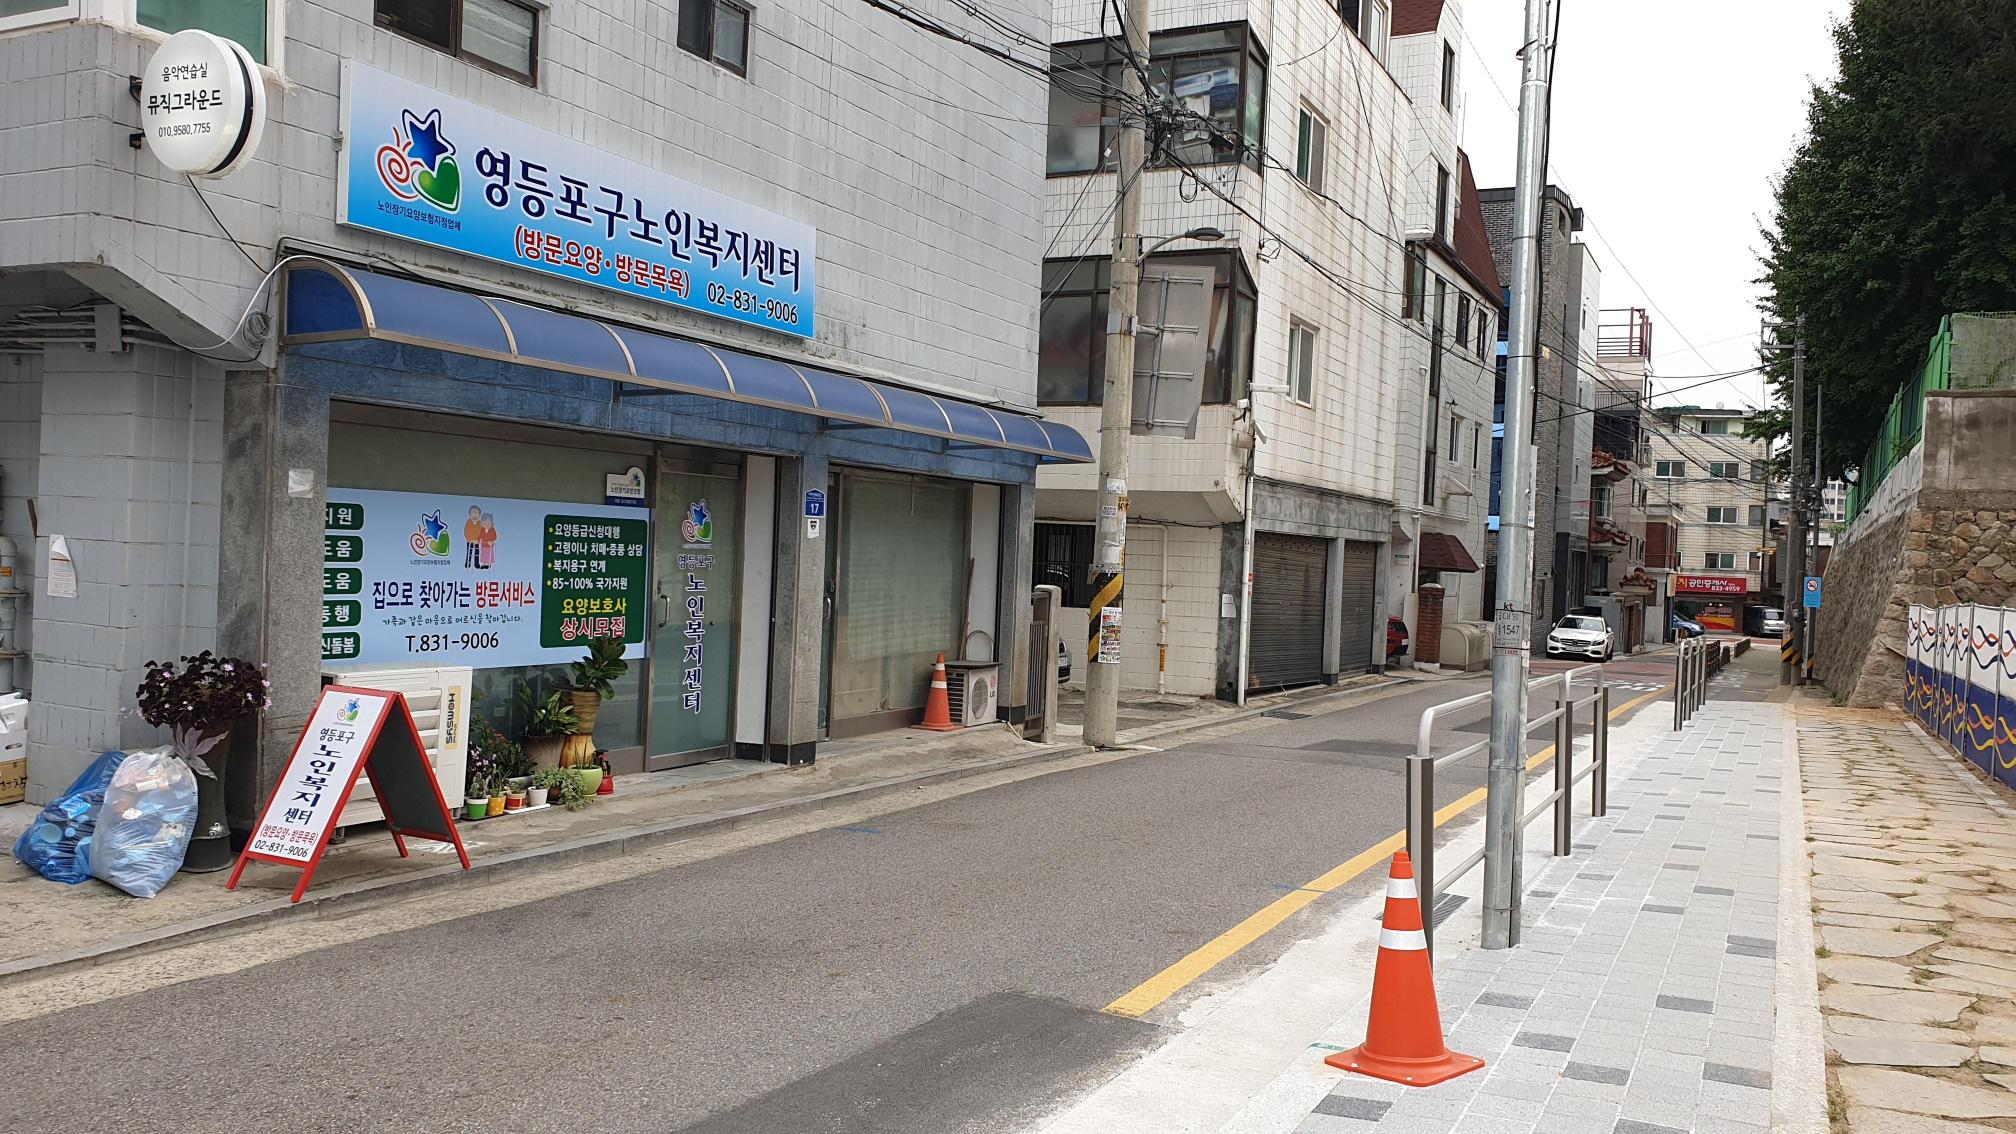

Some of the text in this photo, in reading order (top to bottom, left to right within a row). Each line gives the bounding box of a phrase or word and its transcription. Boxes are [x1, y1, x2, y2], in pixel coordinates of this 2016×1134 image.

[161, 62, 208, 82] 음악연습실
[147, 89, 223, 116] 뮤직그라운드
[475, 147, 800, 293] 영등포구노인복지센터
[707, 282, 798, 325] 02-831-9006
[810, 503, 820, 514] 17
[554, 523, 621, 539] 요양등급신청대행
[553, 541, 588, 555] 고령이나
[627, 543, 644, 557] 상담
[553, 559, 606, 573] 복지용구 연계
[677, 553, 717, 570] 영등포구
[552, 577, 628, 590] 85~100% 국가지원
[1688, 579, 1728, 589] 공인중개사
[372, 580, 535, 610] 집으로 찾아가는 방문서비스
[561, 598, 627, 615] 요양보호사
[1503, 602, 1514, 611] kt
[382, 615, 407, 627] 가족과
[408, 615, 423, 626] 같은
[425, 614, 454, 625] 마음으로
[455, 612, 483, 624] 어르신을
[560, 616, 626, 641] 상시모집
[1502, 624, 1520, 635] 1547
[405, 632, 499, 653] T.831-9006
[319, 728, 355, 745] 영등포구
[283, 808, 313, 826] 센터
[254, 839, 310, 859] 02-831-9006
